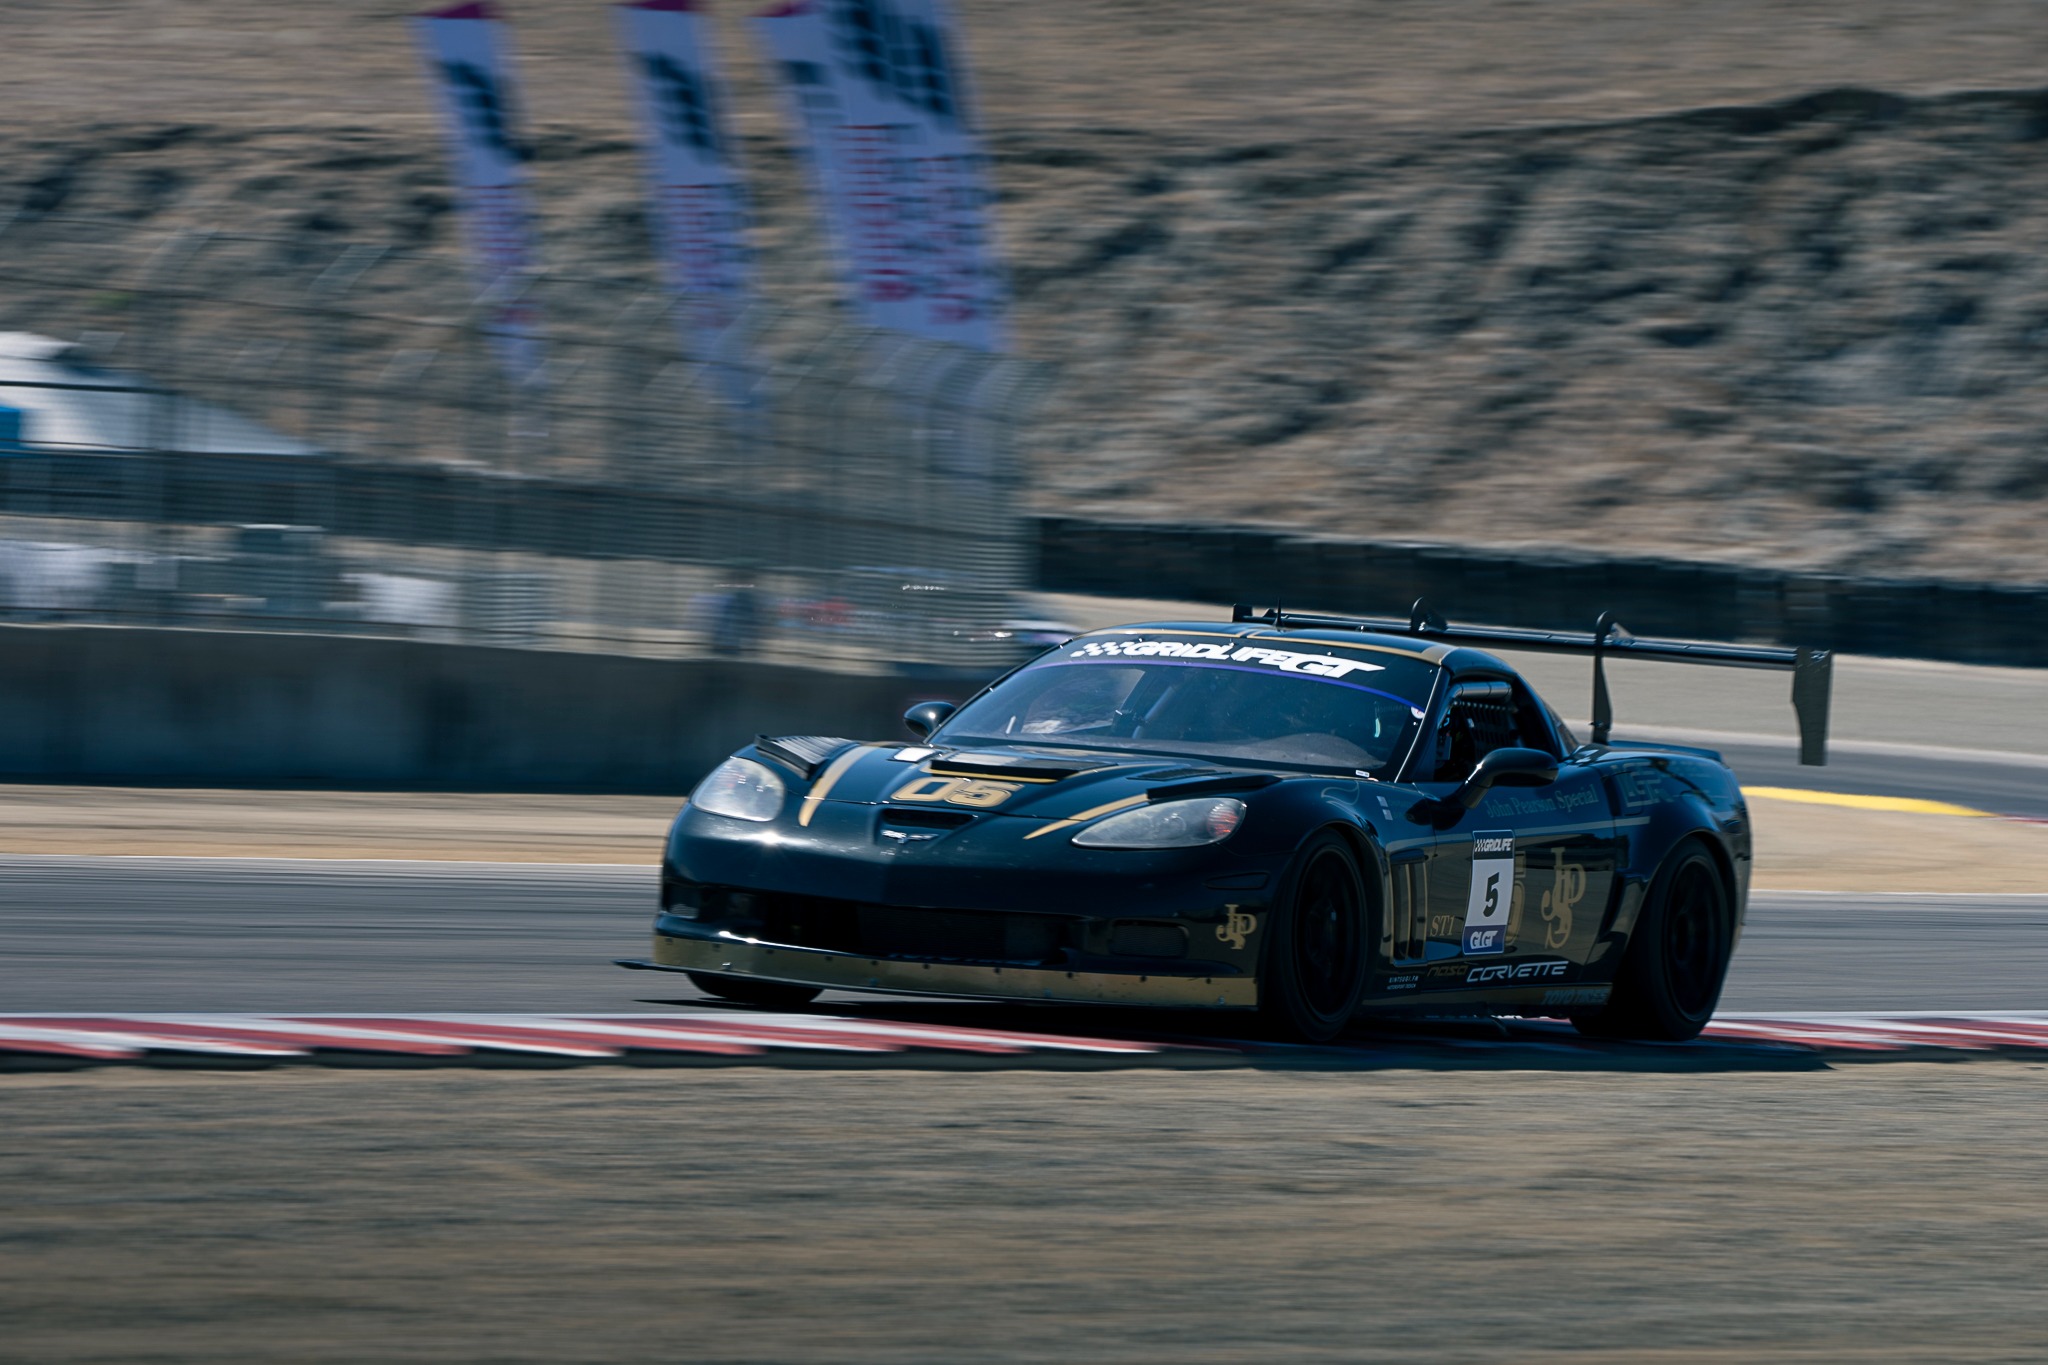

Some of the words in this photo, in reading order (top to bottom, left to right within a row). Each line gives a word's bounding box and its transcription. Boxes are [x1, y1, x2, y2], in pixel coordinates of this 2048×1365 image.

[890, 777, 1022, 807] 05
[1486, 800, 1515, 818] John
[1555, 784, 1599, 813] Special
[1484, 838, 1513, 851] GRIDLIFE
[1483, 872, 1499, 917] 5
[1430, 915, 1454, 937] ST1
[1466, 961, 1569, 983] CORVETTE
